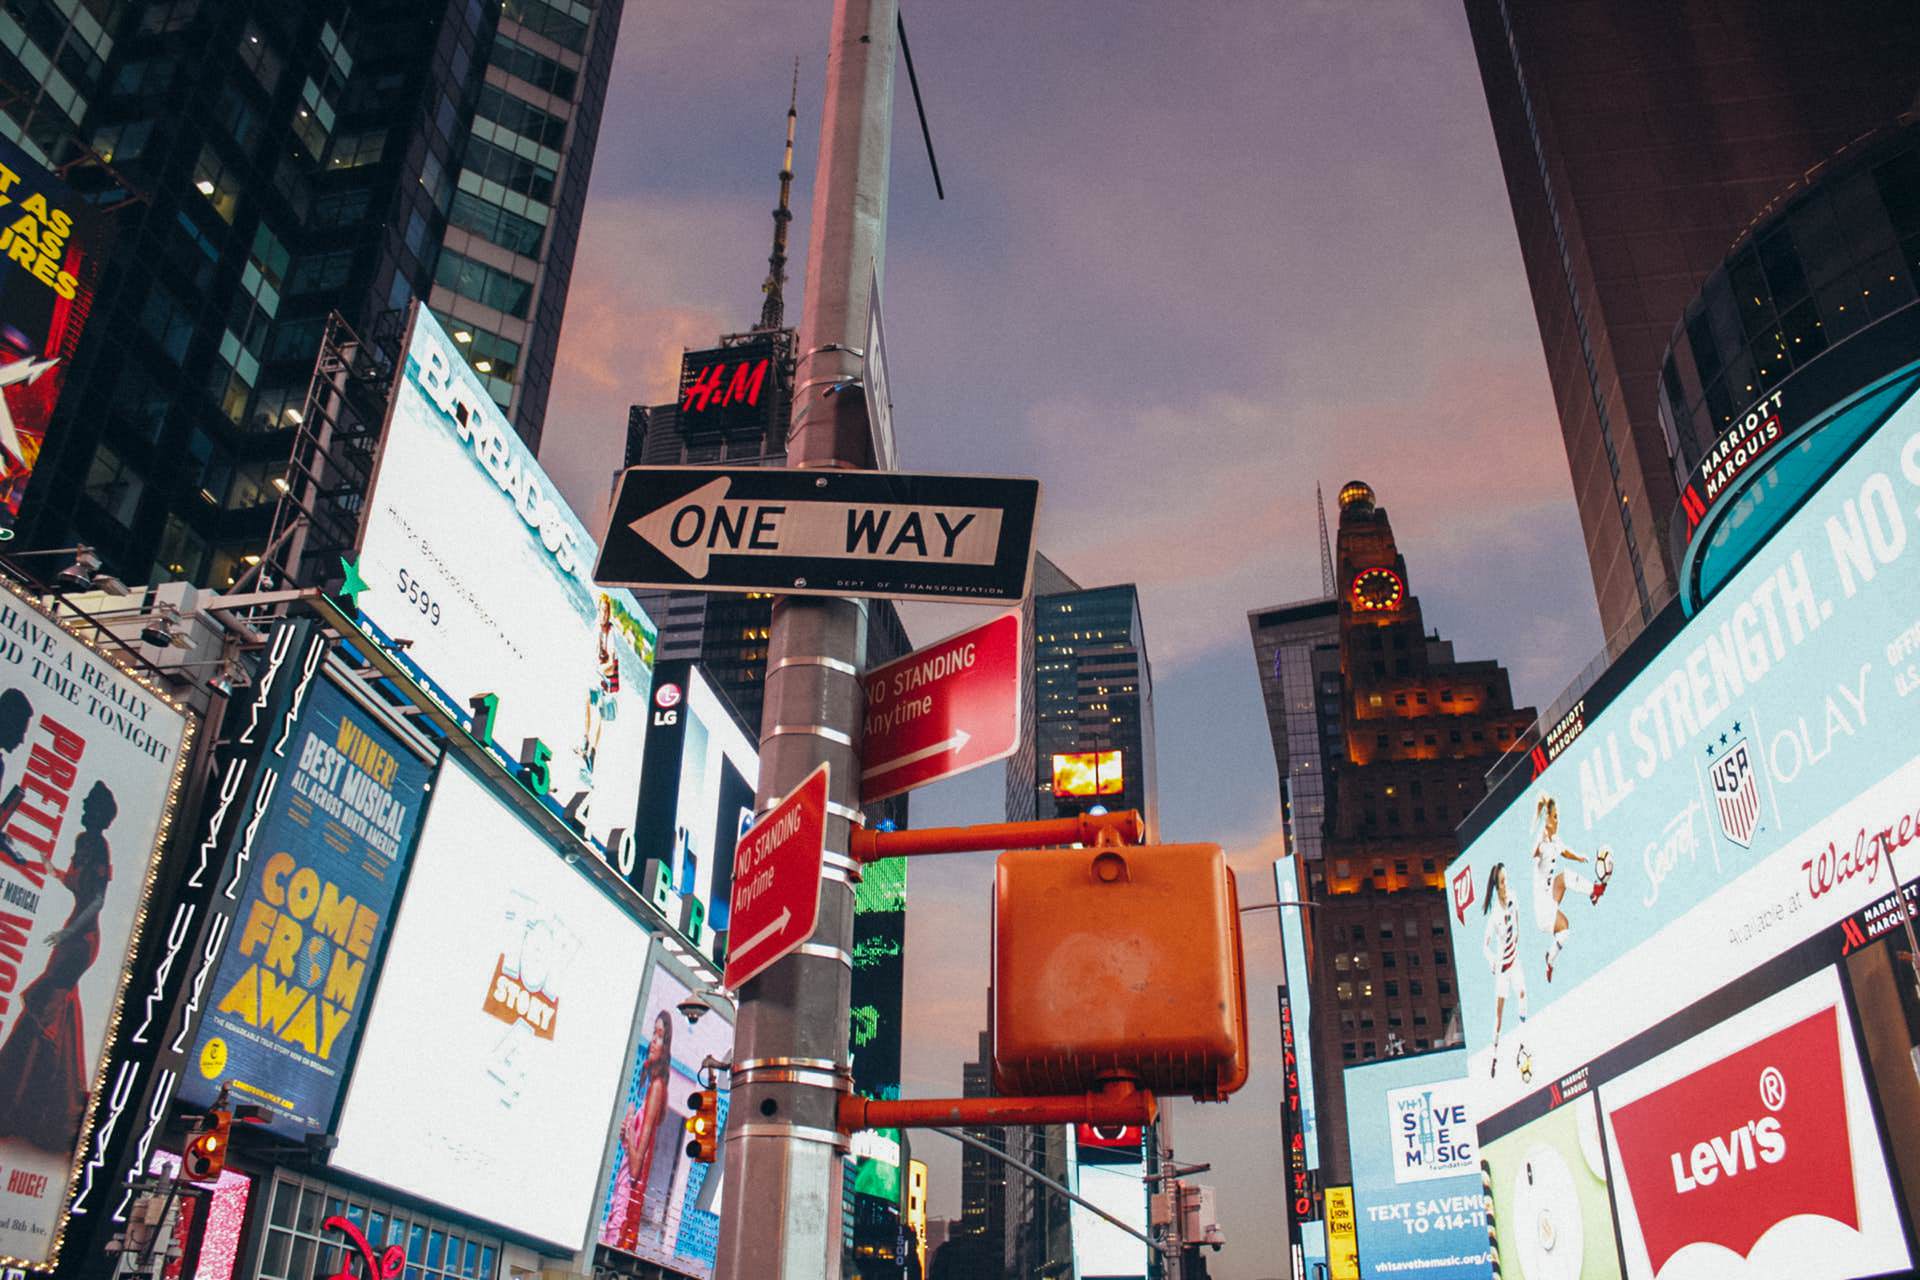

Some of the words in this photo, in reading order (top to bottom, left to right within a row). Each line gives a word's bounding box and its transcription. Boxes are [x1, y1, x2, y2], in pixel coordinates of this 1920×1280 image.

[10, 214, 64, 260] AS
[20, 192, 74, 238] AS
[682, 359, 769, 412] H&M
[418, 338, 578, 574] BARBADOS
[1702, 390, 1782, 480] MARRIOTT
[1706, 421, 1778, 499] MARQUIS
[669, 504, 786, 551] ONE
[845, 507, 976, 558] WAY
[836, 580, 865, 588] DEPT
[876, 581, 891, 589] OF
[903, 583, 1005, 595] TRANSPORTATION
[0, 605, 57, 659] HAVE
[60, 650, 75, 673] A
[79, 661, 152, 722] REALLY
[865, 680, 886, 705] NO
[894, 643, 976, 696] STANDING
[1580, 725, 1636, 831] ALL
[1629, 550, 1833, 778] STRENGTH.
[1825, 472, 1907, 599] NO
[31, 656, 82, 706] TIME
[88, 694, 171, 764] TONIGHT
[654, 711, 678, 726] LG
[863, 695, 933, 737] Anytime
[1546, 700, 1584, 747] MARRIOTT
[1770, 663, 1871, 783] OLAY
[336, 716, 399, 792] WINNER!
[1549, 719, 1583, 761] MARQUIS
[298, 731, 347, 792] BEST
[340, 764, 407, 840] MUSICAL
[1713, 747, 1748, 793] USA
[291, 770, 307, 796] ALL
[308, 780, 344, 819] ACROSS
[341, 804, 369, 840] NORTH
[364, 826, 401, 862] AMERICA
[737, 849, 752, 876] NO
[754, 804, 802, 866] STANDING
[3, 881, 41, 915] MUSICAL
[262, 852, 380, 961] COME
[735, 865, 775, 914] Anytime
[1867, 903, 1917, 937] MARQUS
[216, 963, 352, 1061] AWAY
[492, 974, 556, 1032] STORY
[7, 1169, 49, 1200] HUGE!
[1429, 1160, 1473, 1171] foundation
[1330, 1208, 1349, 1220] LION
[1330, 1220, 1353, 1234] KING
[1332, 1199, 1346, 1208] THE
[1367, 1202, 1411, 1221] TEXT
[1403, 1217, 1429, 1235] TO
